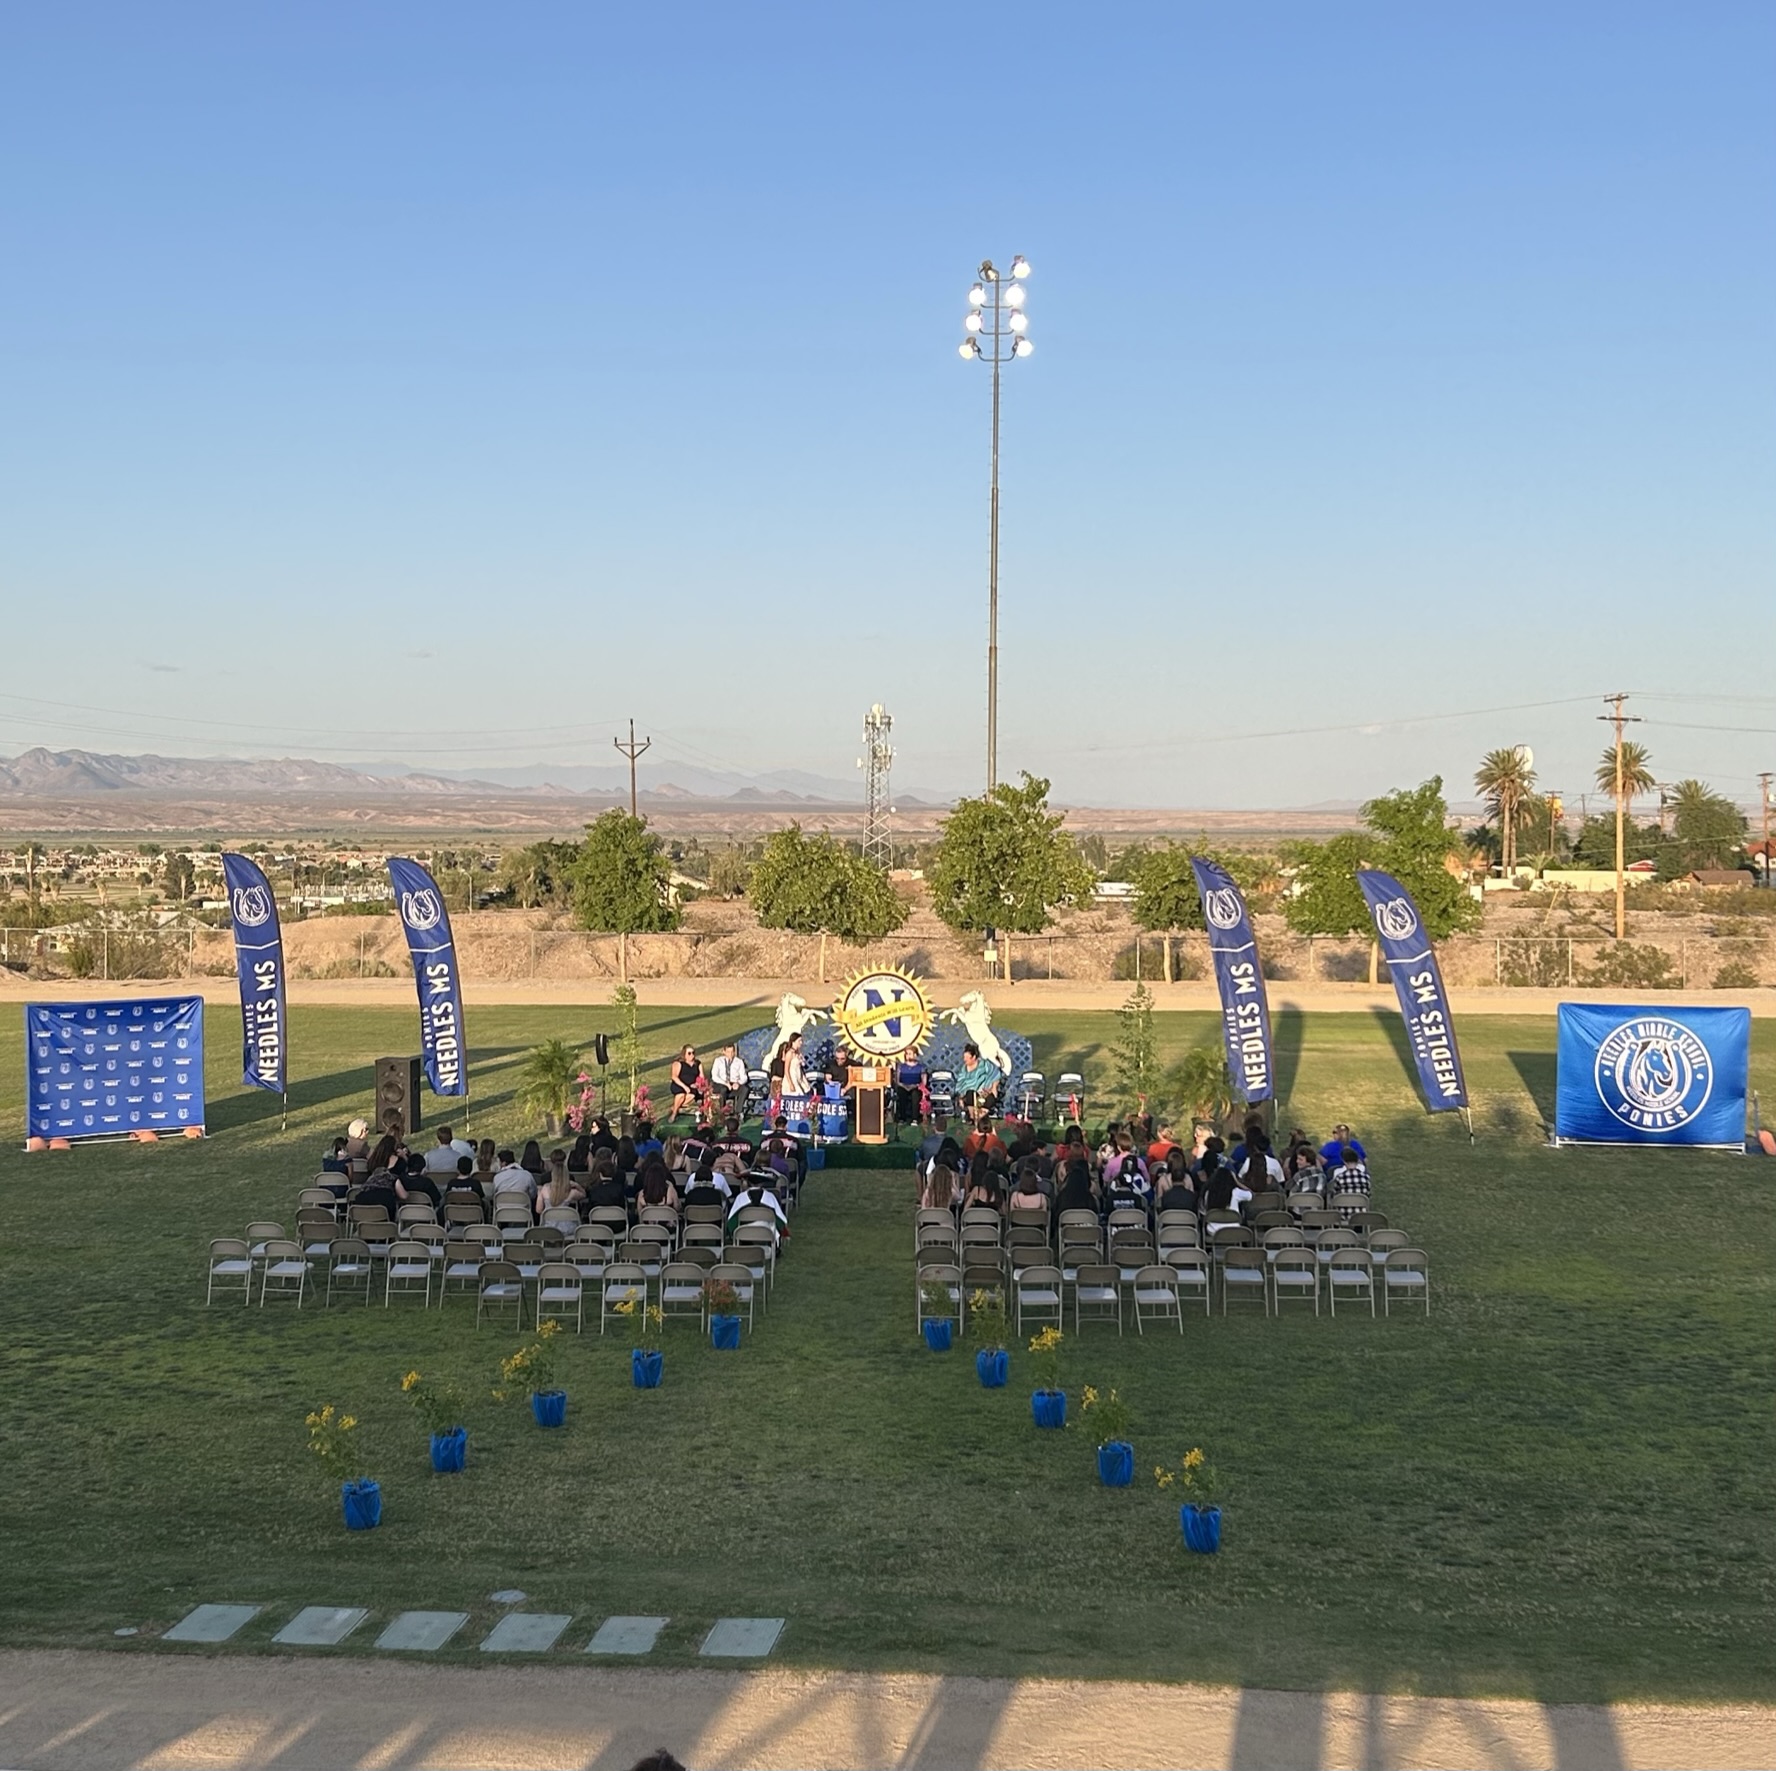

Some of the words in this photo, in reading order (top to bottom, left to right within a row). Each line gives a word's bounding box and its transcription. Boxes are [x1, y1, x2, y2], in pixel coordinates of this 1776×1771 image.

[254, 960, 278, 992] MS
[427, 962, 451, 995] MS
[1230, 961, 1257, 995] MS
[1410, 970, 1439, 1005] MS
[863, 989, 905, 1038] N
[257, 997, 280, 1082] NEEDLES
[431, 1001, 459, 1088] NEEDLES
[1237, 1002, 1268, 1091] NEEDLES
[1421, 1010, 1461, 1098] NEEDLES
[770, 1099, 805, 1113] NEDLES
[1617, 1102, 1690, 1127] PONIES
